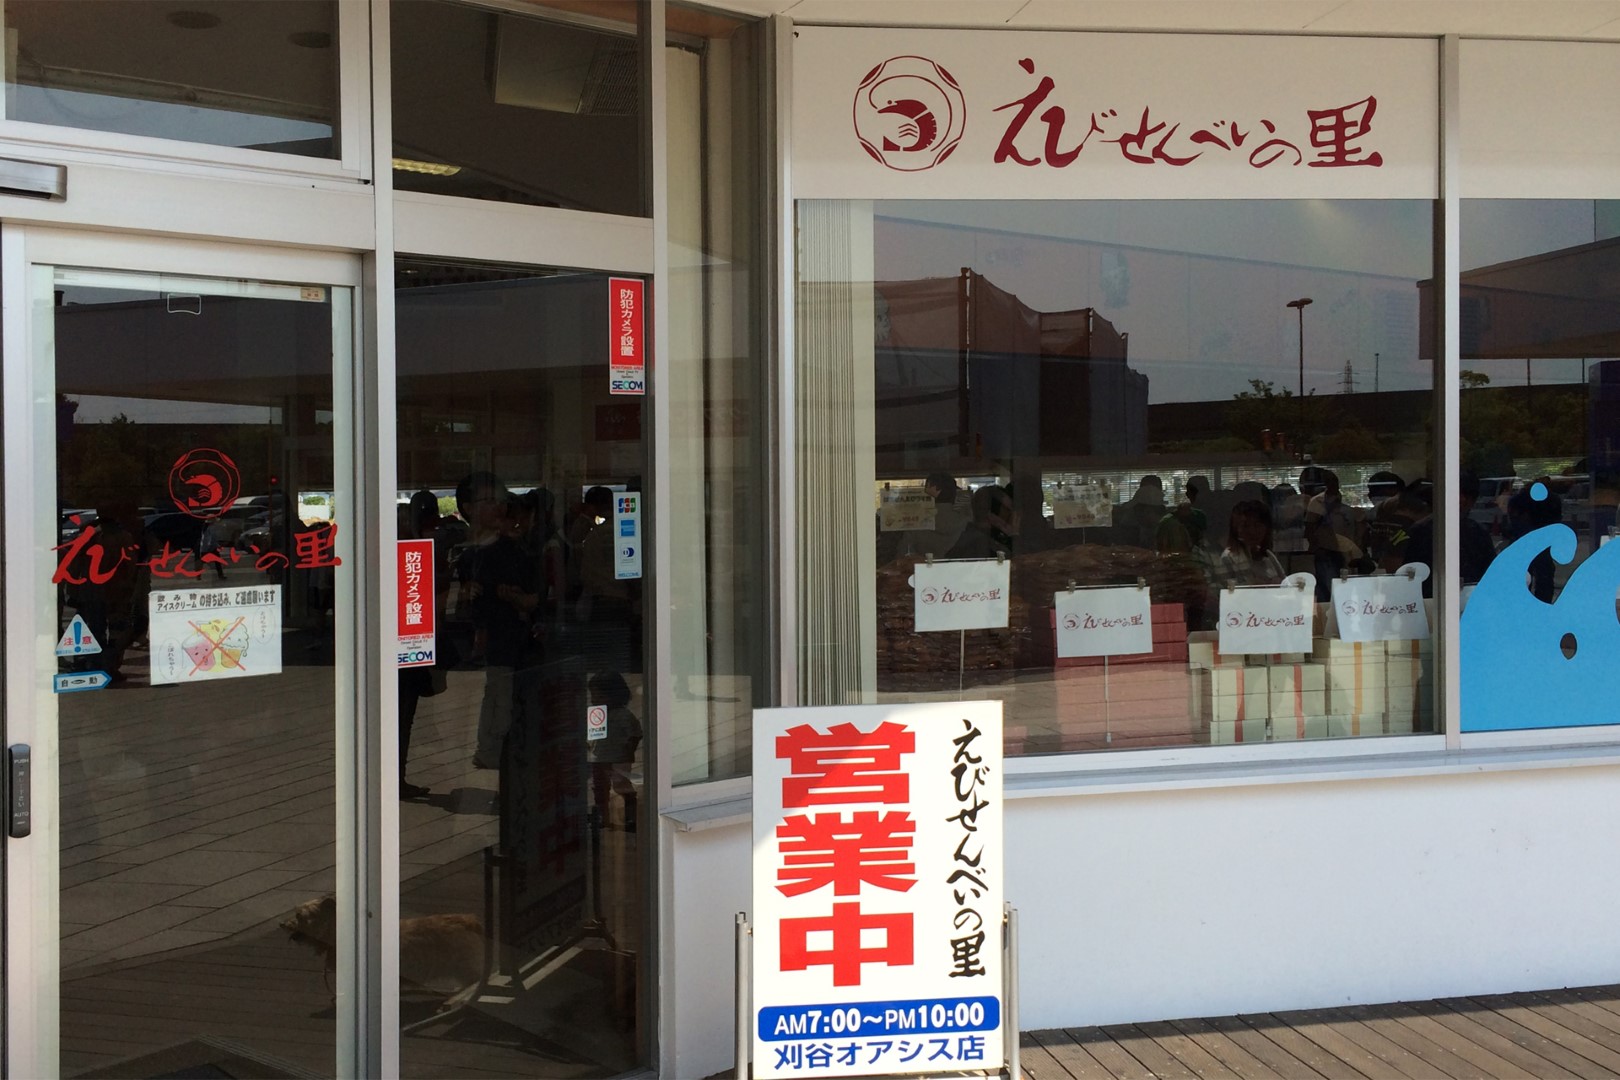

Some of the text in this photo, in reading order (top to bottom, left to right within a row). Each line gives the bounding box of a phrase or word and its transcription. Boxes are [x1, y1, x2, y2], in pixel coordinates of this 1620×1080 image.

[993, 58, 1384, 169] えびせんべいの里
[619, 288, 634, 357] 防犯カメラ設置
[612, 380, 643, 390] SECOM
[52, 514, 342, 585] えびせんべいの里
[157, 601, 197, 611] アイスクリーム
[405, 551, 423, 626] 防犯カメラ設置
[14, 810, 29, 818] AUTO
[946, 718, 990, 979] えびせんべいの里
[774, 720, 919, 988] 営業中
[774, 1035, 985, 1070] 刈谷オアシス店
